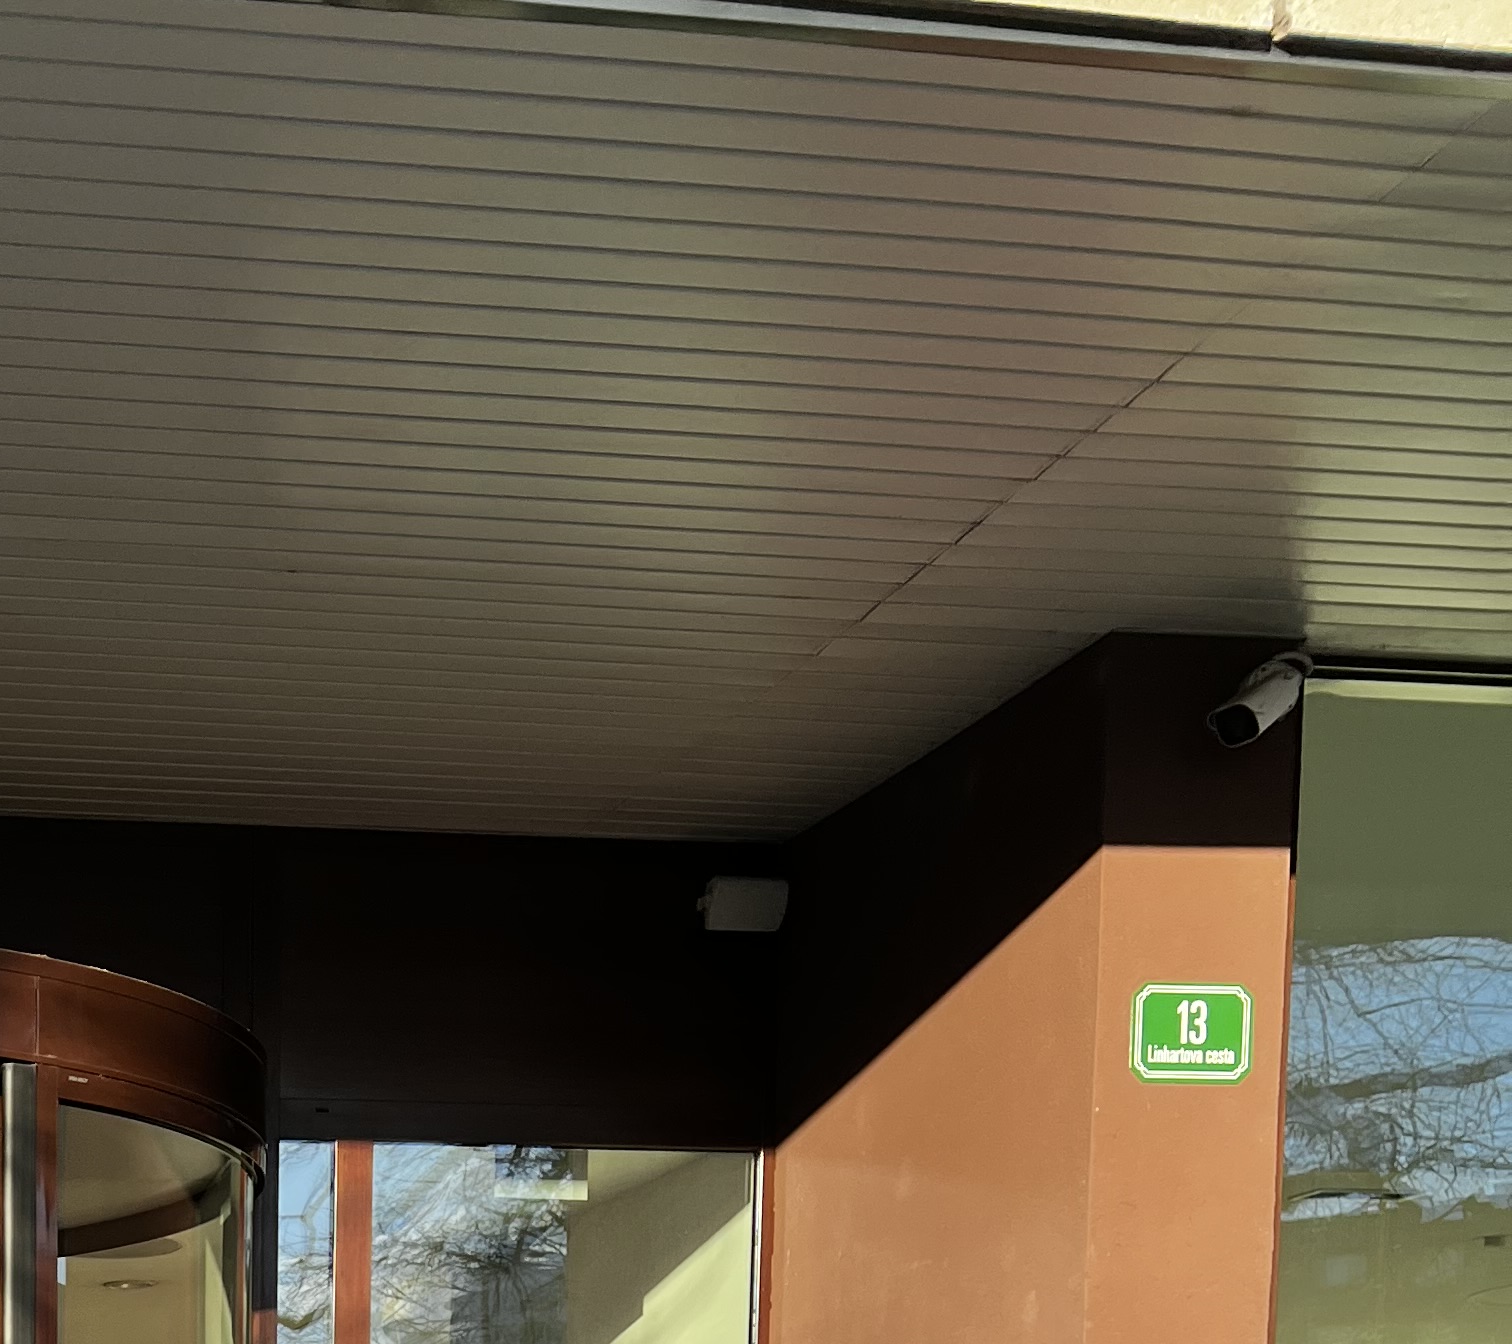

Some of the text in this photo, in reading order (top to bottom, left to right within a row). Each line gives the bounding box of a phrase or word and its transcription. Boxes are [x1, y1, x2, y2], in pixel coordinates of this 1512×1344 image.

[1176, 999, 1208, 1045] 13
[1147, 1044, 1235, 1065] Linhartova cesta
